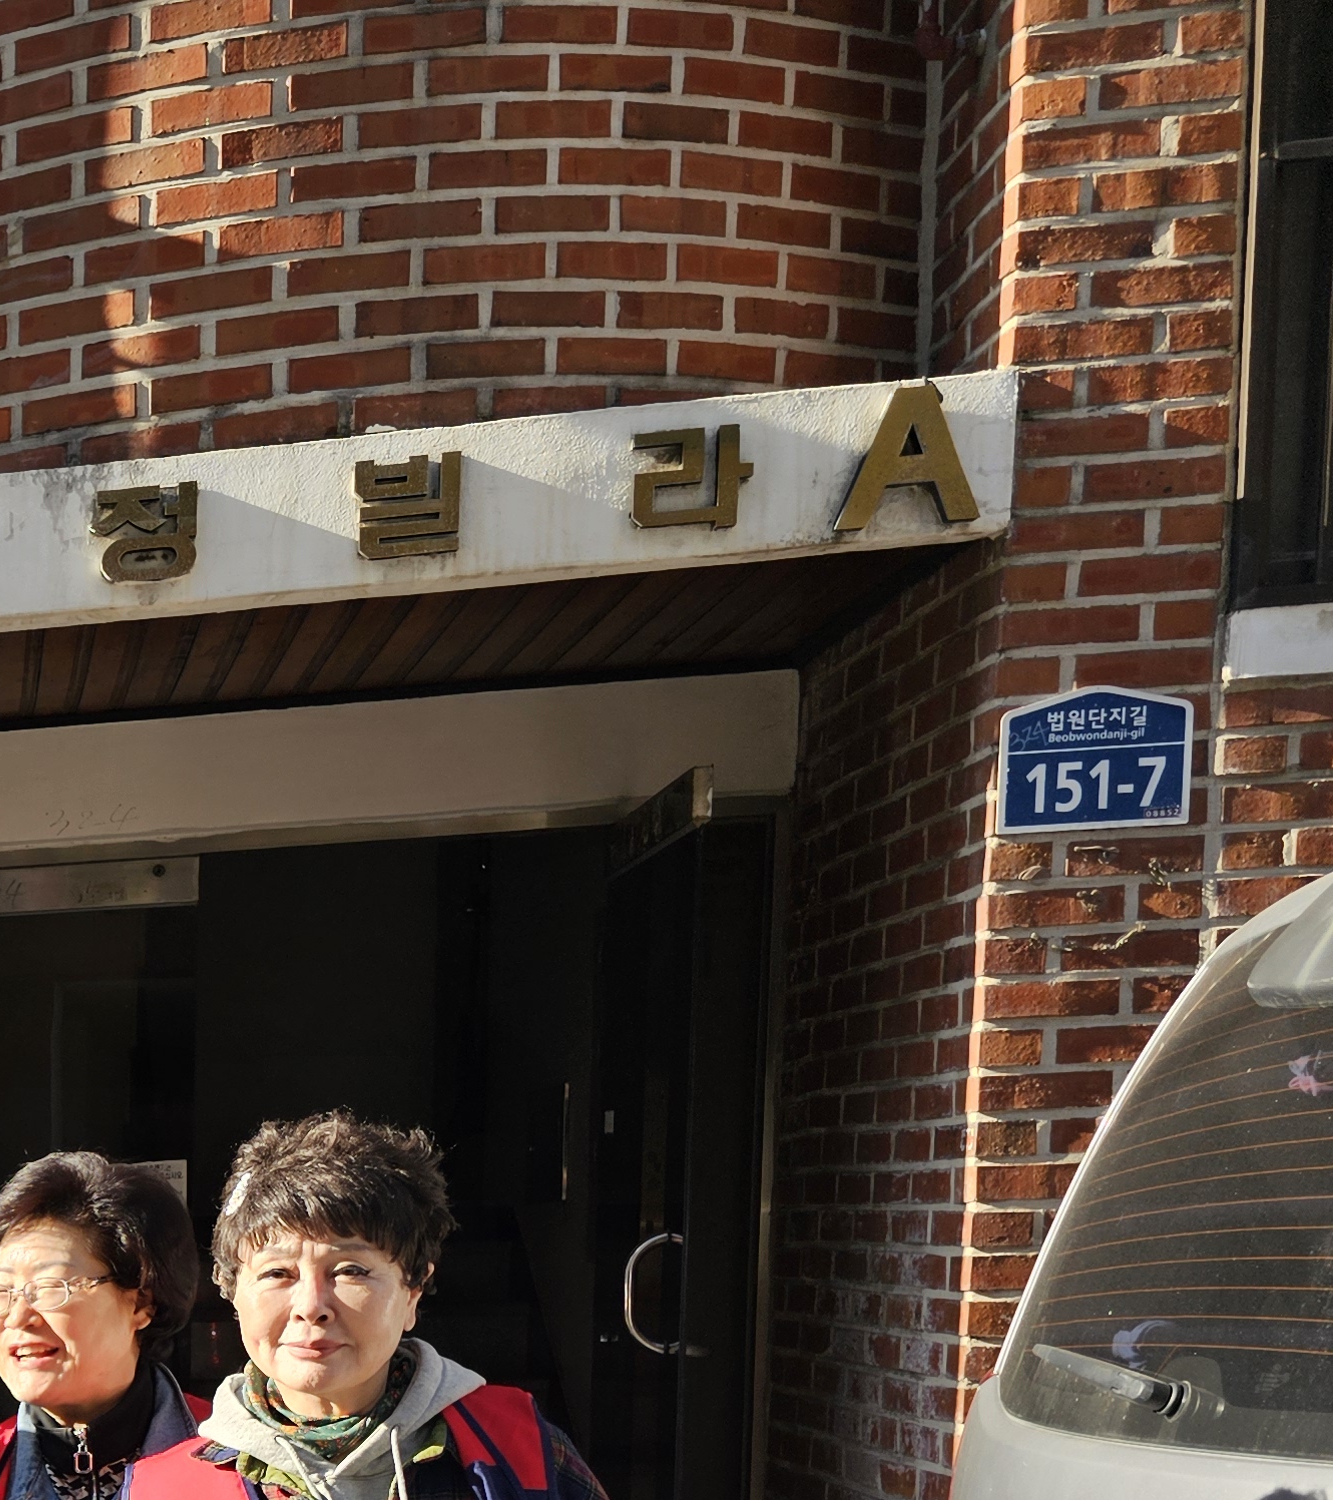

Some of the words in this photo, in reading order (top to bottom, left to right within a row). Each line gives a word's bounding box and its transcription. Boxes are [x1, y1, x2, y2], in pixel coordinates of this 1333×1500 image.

[834, 384, 981, 532] A
[1046, 705, 1148, 732] 법원단지길
[1047, 727, 1146, 744] Beobwondanji-gil
[1025, 755, 1167, 815] 151-7
